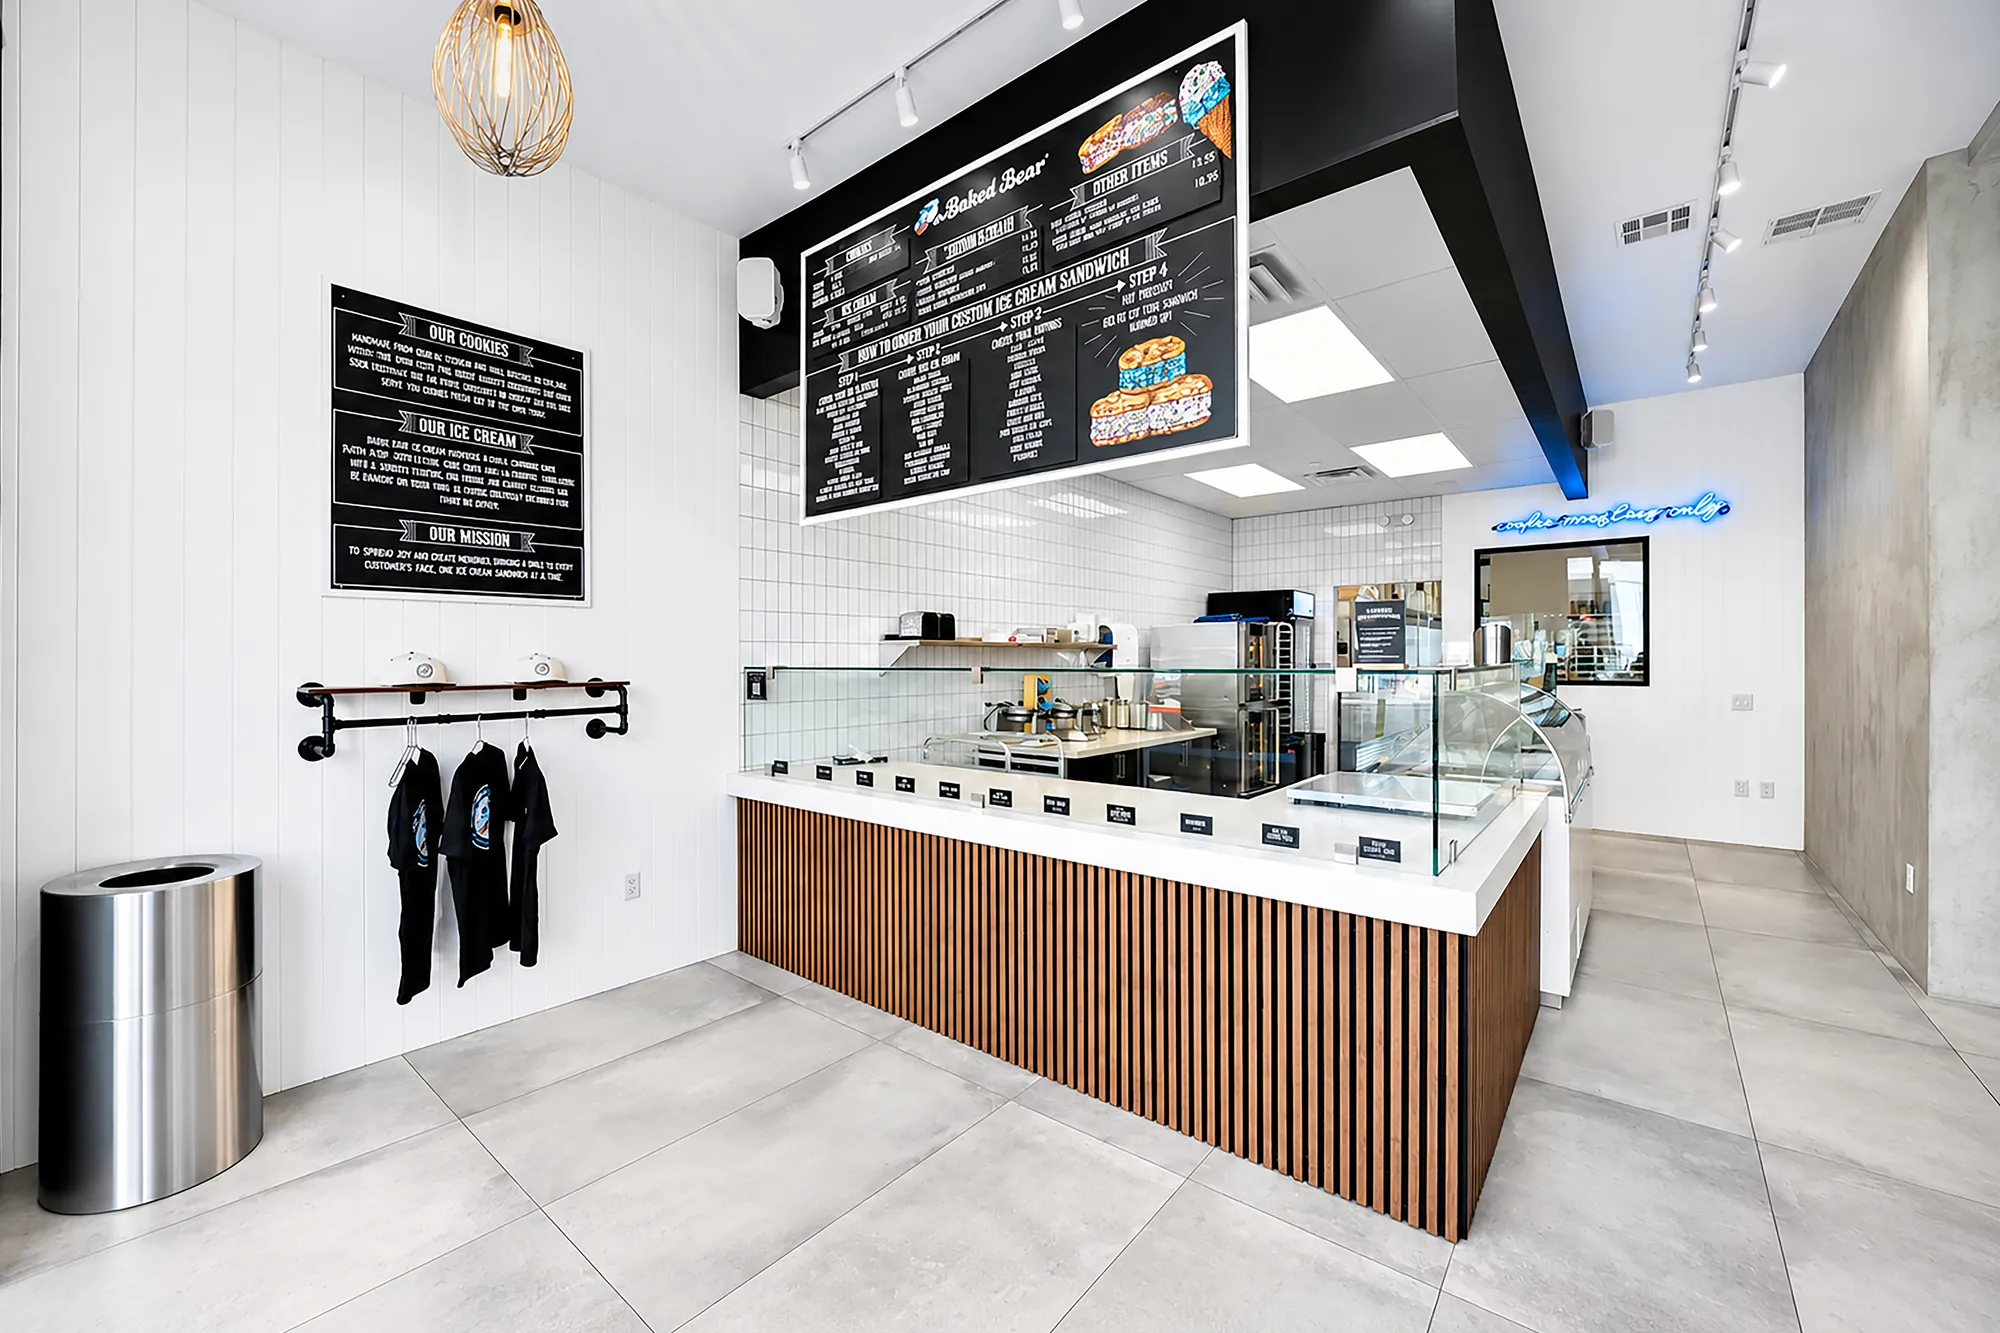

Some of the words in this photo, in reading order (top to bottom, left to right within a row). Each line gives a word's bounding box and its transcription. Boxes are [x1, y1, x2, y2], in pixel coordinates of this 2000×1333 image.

[1092, 170, 1129, 196] OTHER
[1131, 149, 1168, 180] ITEMS
[943, 177, 998, 220] Baked
[998, 159, 1046, 194] Bear
[1129, 265, 1157, 288] STEP
[1158, 261, 1168, 277] 4
[878, 338, 891, 355] TO
[951, 300, 994, 330] CUSTOM
[995, 293, 1013, 313] ICE
[1014, 275, 1057, 307] CREAM
[1059, 247, 1130, 291] SANDWICH
[1010, 310, 1034, 329] STEP
[429, 324, 456, 345] OUR
[459, 332, 509, 358] COOKIES
[419, 417, 446, 436] OUR
[449, 422, 470, 440] ICE
[473, 428, 517, 449] CREAM
[348, 545, 360, 556] TO
[429, 526, 456, 543] OUR
[459, 528, 510, 548] MISSION
